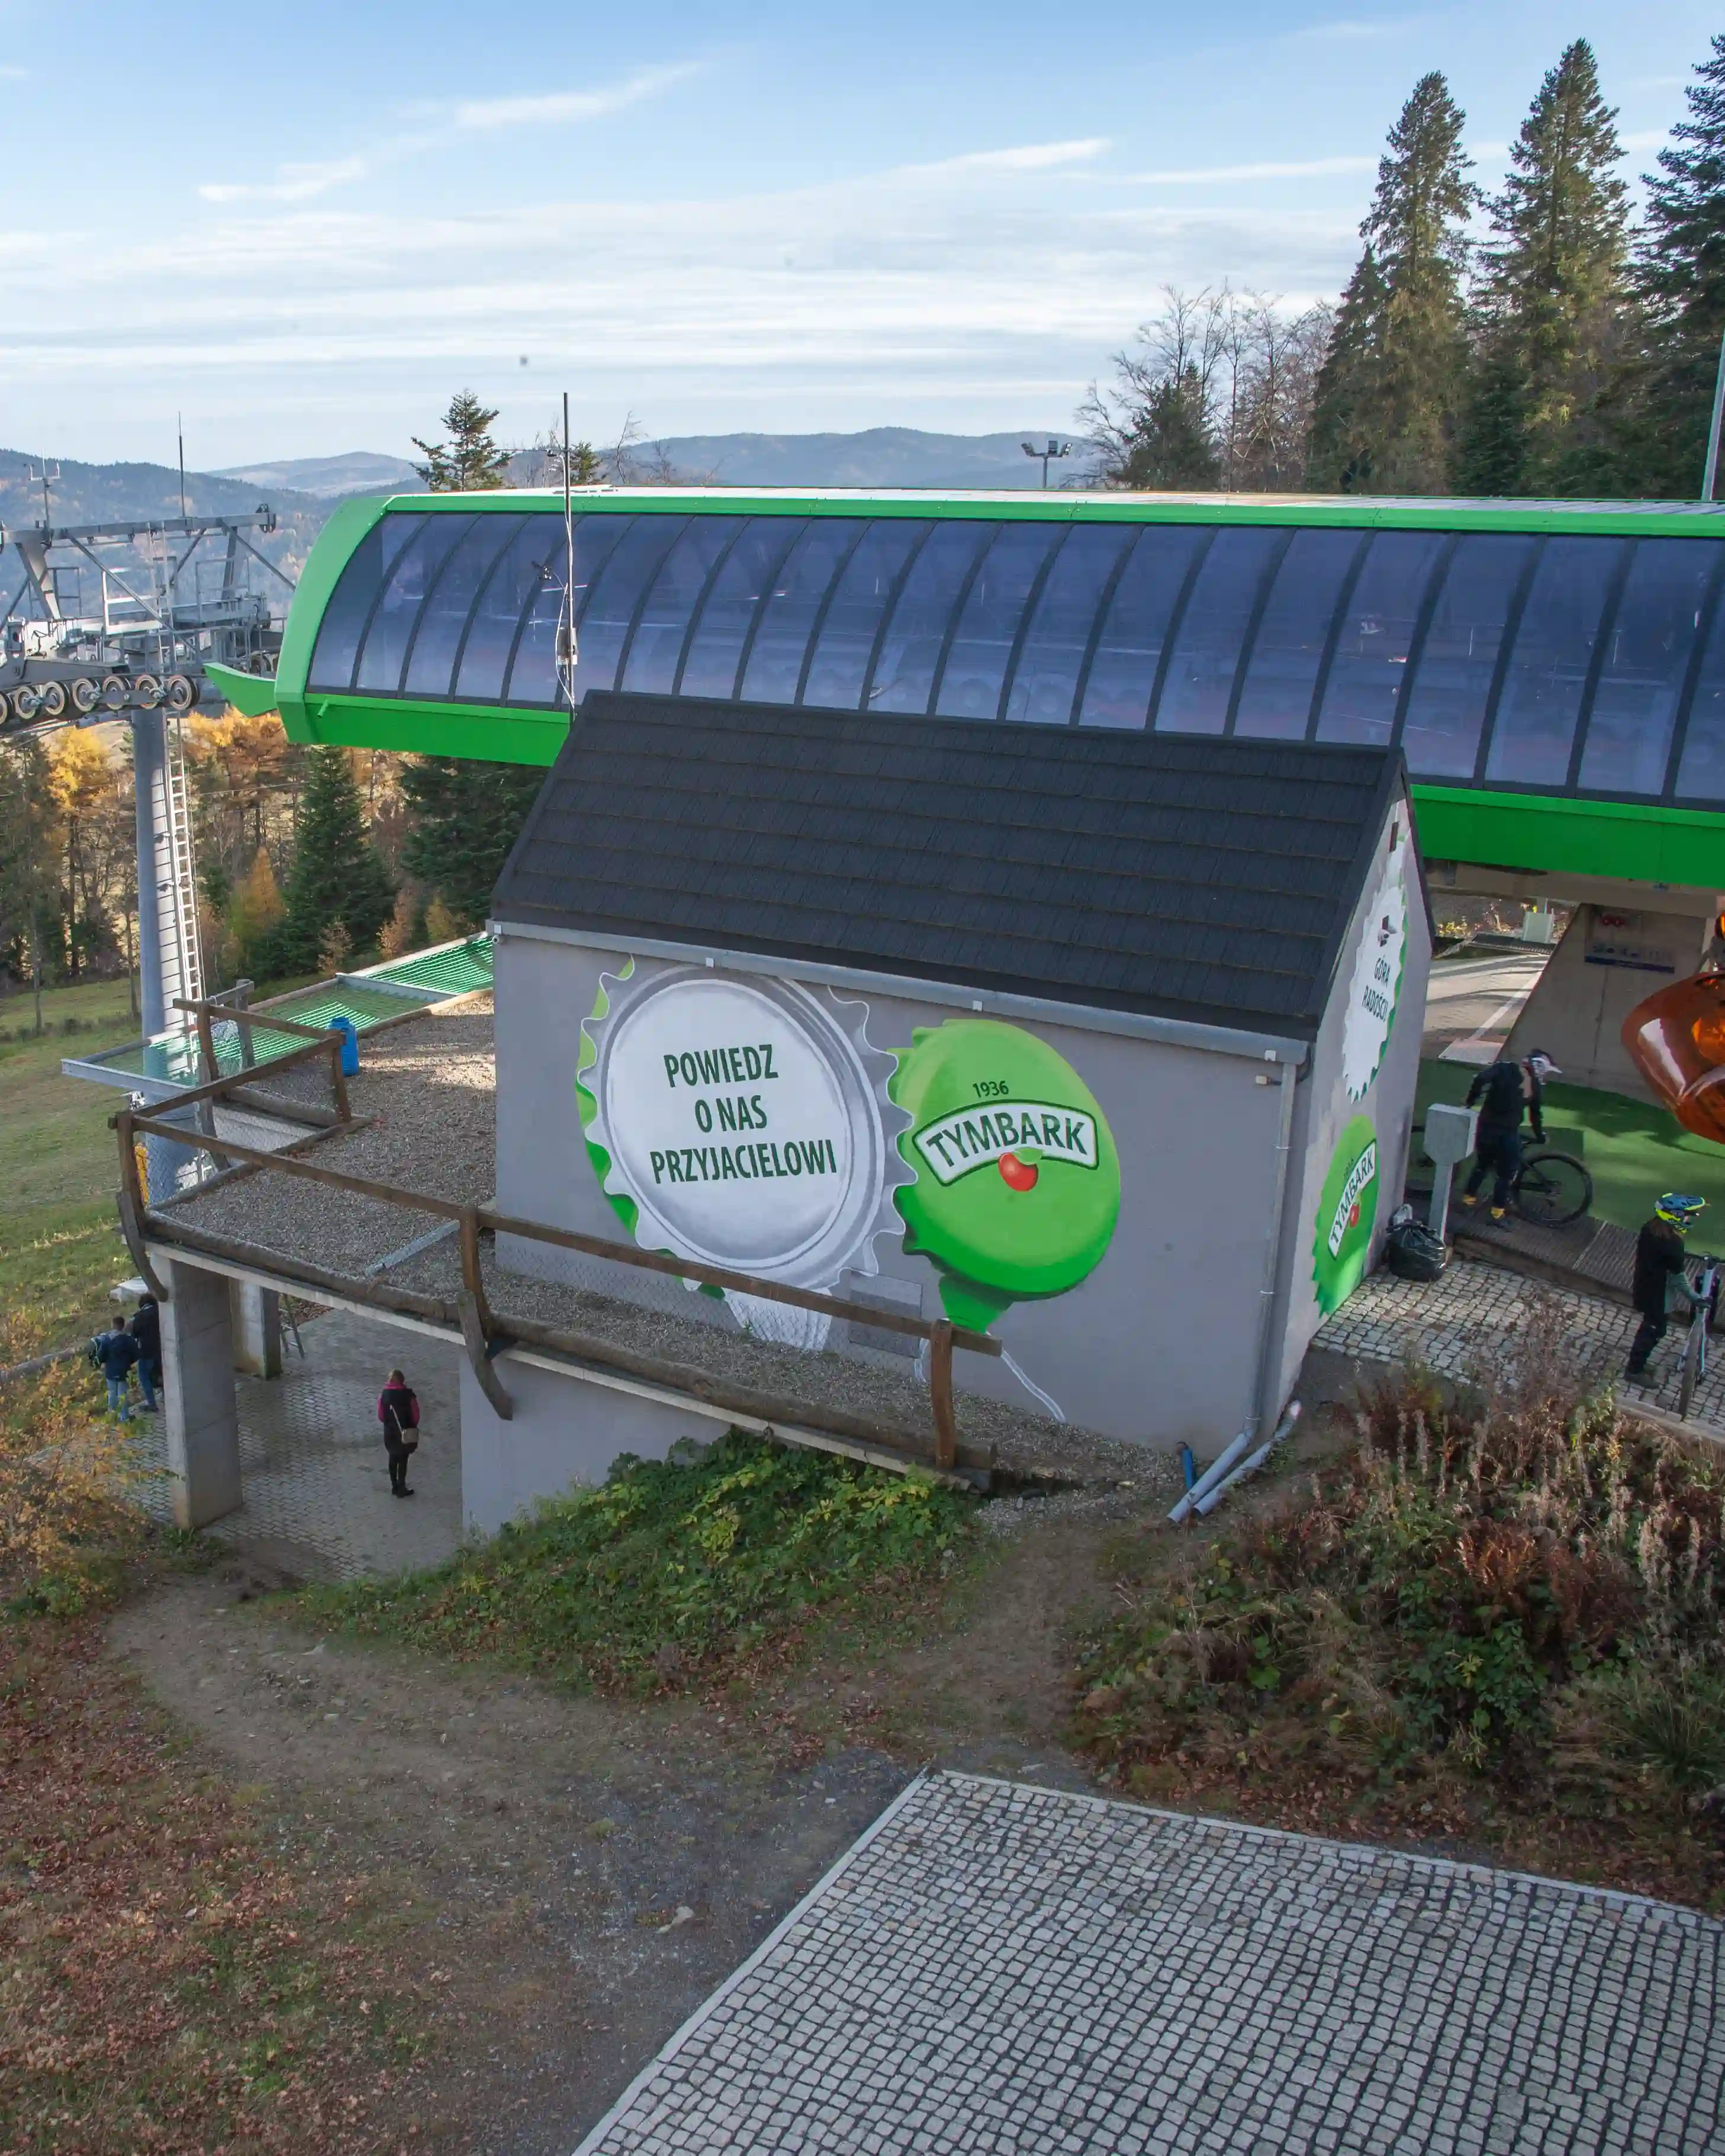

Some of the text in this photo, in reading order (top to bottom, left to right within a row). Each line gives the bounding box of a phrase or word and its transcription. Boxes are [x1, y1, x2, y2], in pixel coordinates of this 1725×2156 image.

[1374, 954, 1391, 987] GÓRA
[664, 1044, 778, 1087] POWIEDZ
[973, 1080, 1009, 1098] 1936
[694, 1095, 767, 1132] O NAS
[926, 1112, 1087, 1167] TYMBARK
[650, 1140, 837, 1184] PRZYJACIELOWI
[1330, 1148, 1373, 1244] TYMBARK
